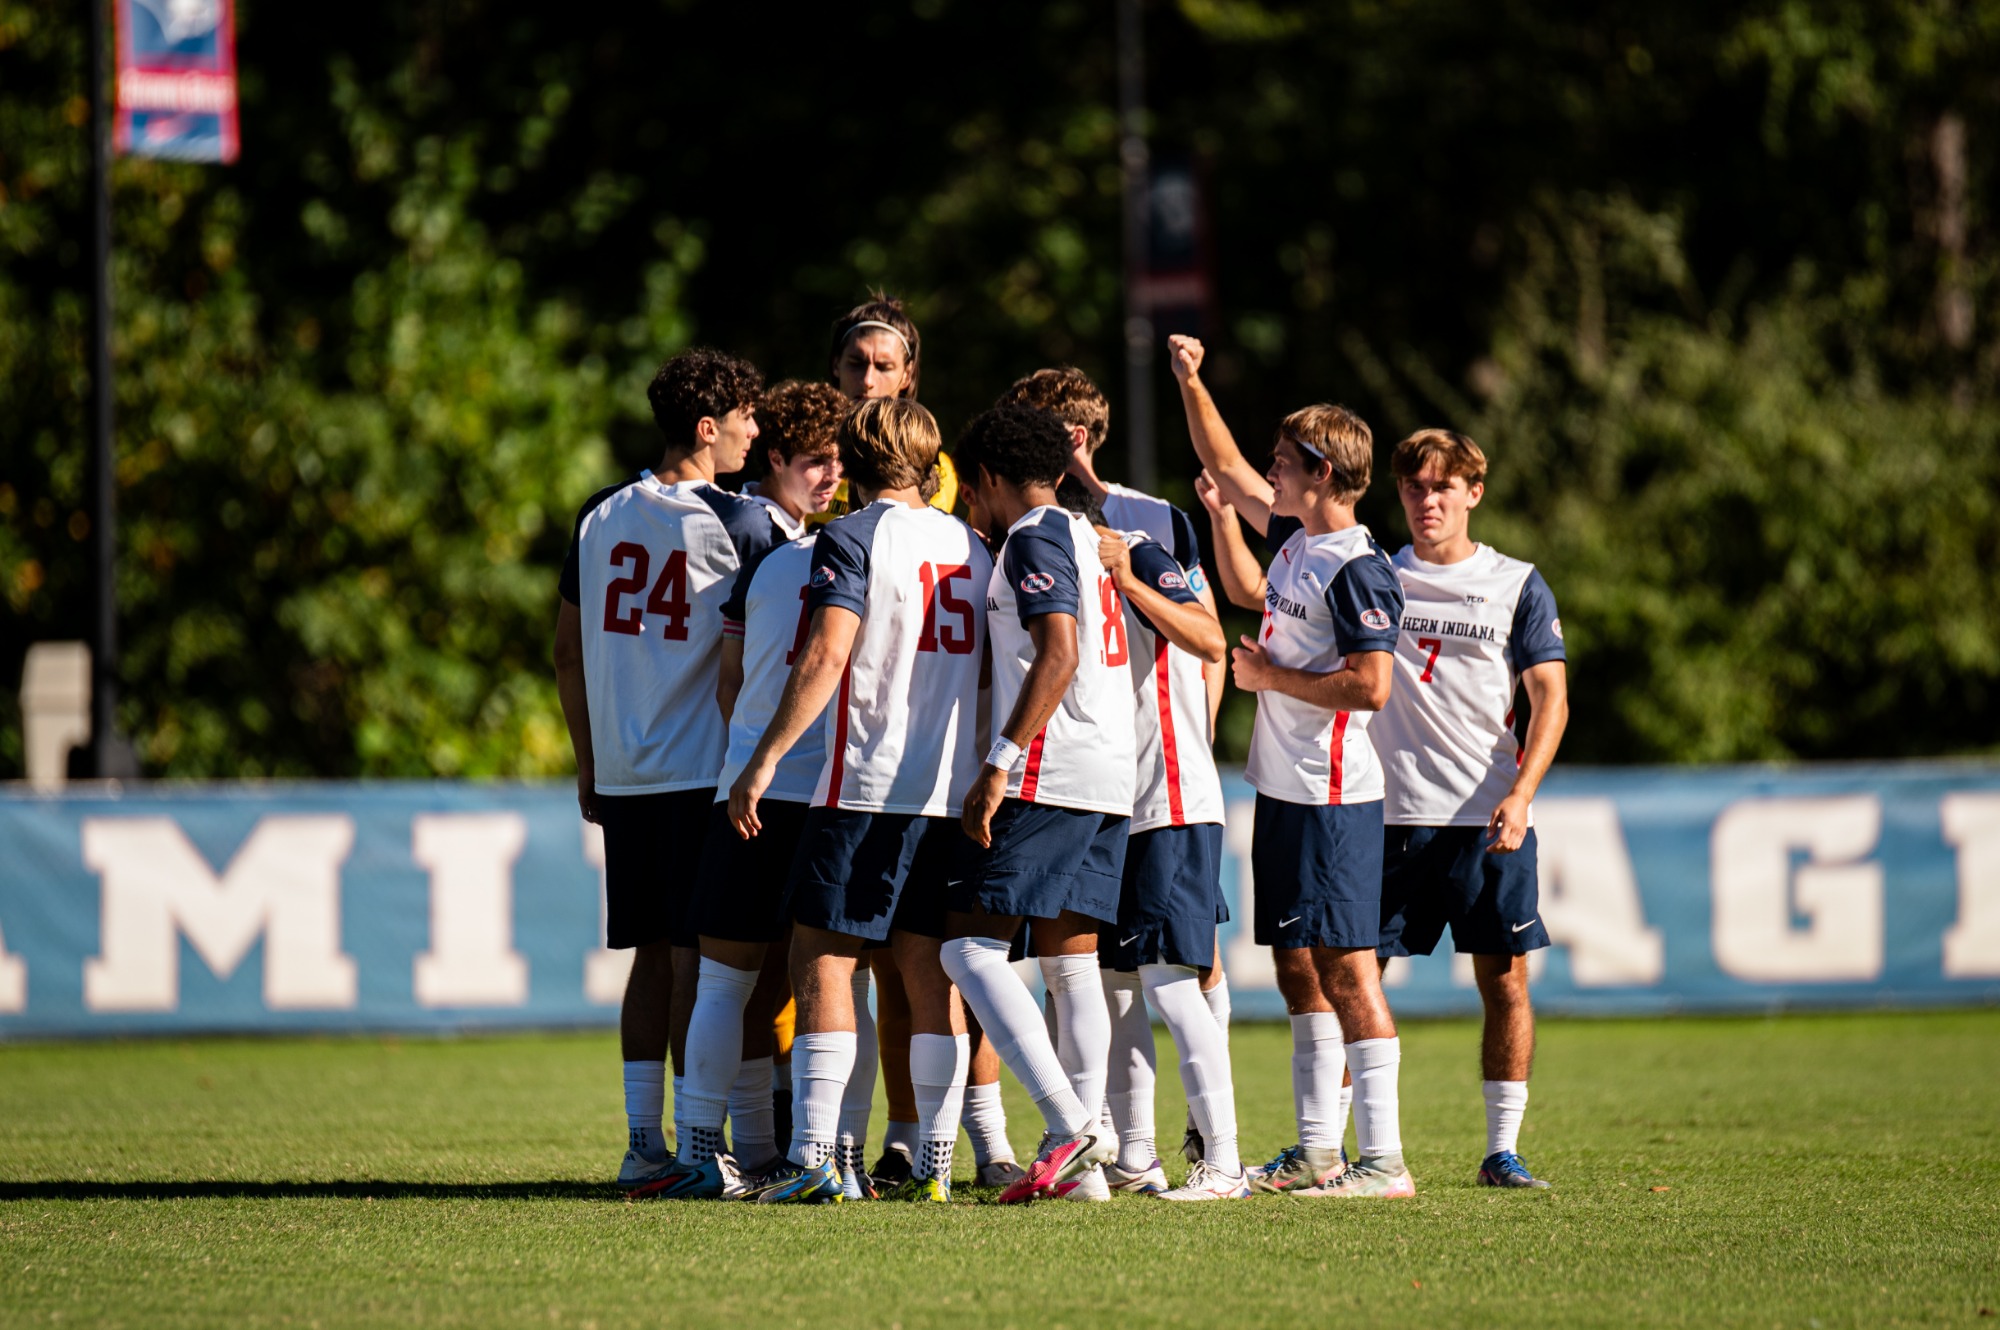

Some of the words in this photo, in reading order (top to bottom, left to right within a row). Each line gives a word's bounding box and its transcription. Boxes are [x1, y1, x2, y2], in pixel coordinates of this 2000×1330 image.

[604, 541, 691, 641] 24
[917, 561, 974, 654] 15
[1418, 637, 1441, 683] 7
[1441, 621, 1495, 642] INDIANA
